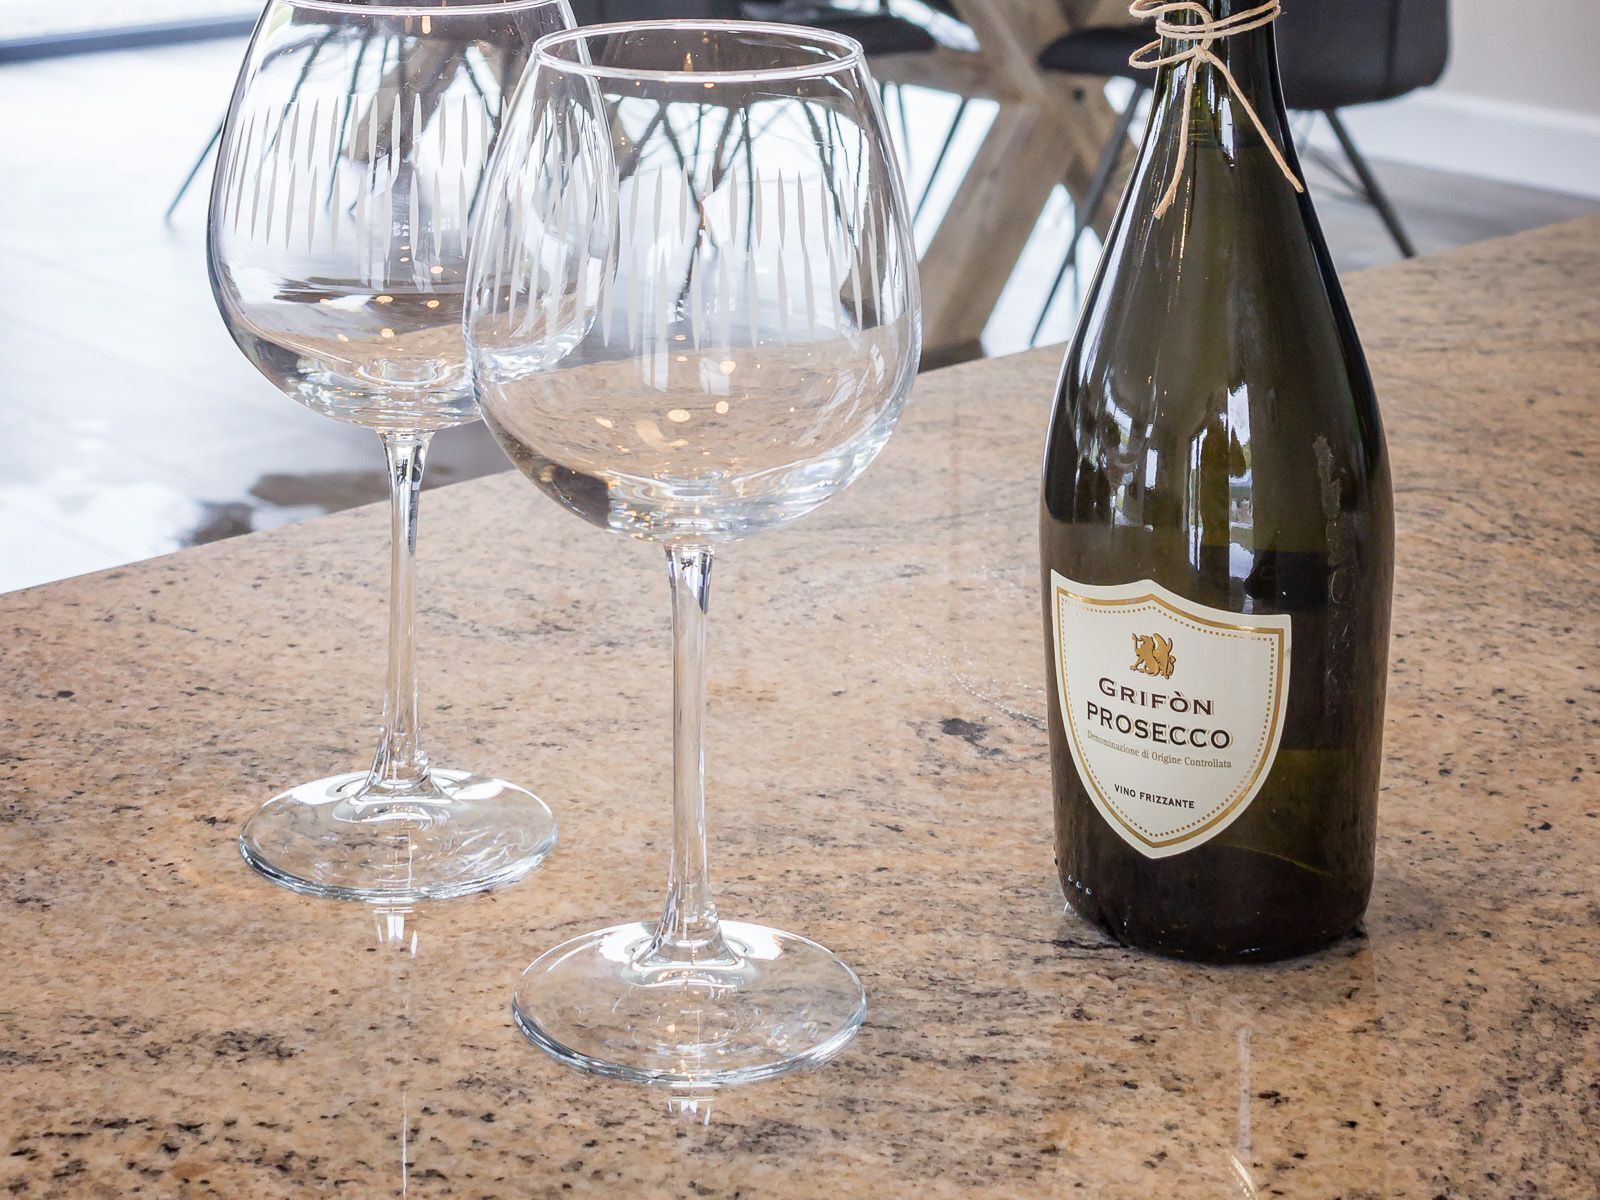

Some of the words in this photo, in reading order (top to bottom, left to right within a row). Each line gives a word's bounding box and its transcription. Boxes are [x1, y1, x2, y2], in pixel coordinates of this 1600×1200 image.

[1099, 677, 1214, 716] GRIFÒN
[1086, 700, 1233, 749] PROSECCO
[1087, 729, 1140, 757] Denominazione
[1141, 749, 1149, 760] di
[1151, 751, 1182, 766] Origine
[1184, 756, 1232, 769] Controllata
[1114, 783, 1136, 798] VINO
[1139, 791, 1195, 809] FRIZZANTE
